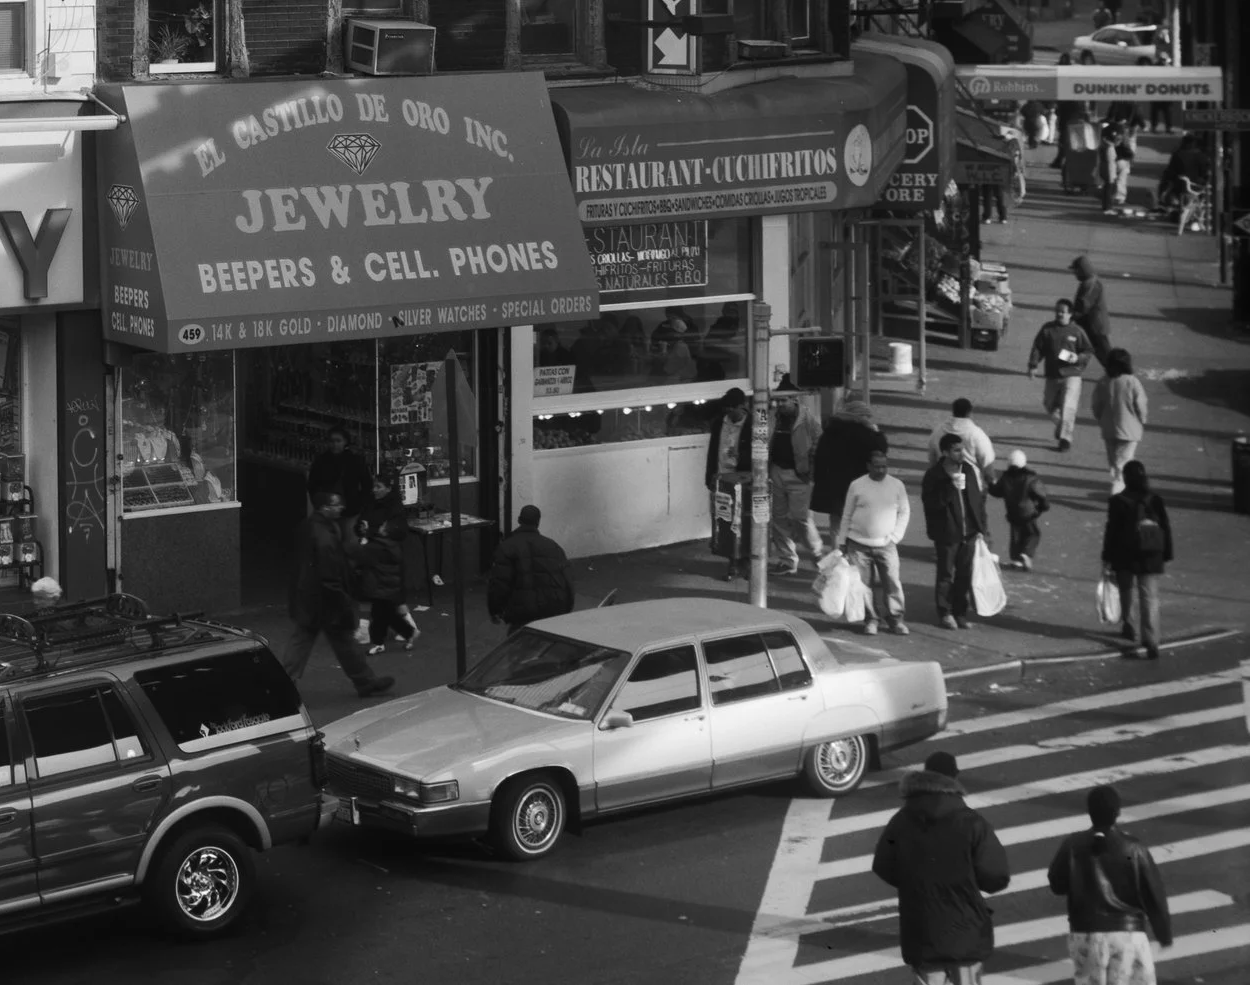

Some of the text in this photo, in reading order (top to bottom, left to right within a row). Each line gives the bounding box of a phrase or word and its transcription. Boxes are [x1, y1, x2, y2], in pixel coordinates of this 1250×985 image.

[1073, 83, 1142, 95] DUNKIN'
[1145, 84, 1212, 95] DONUTS
[192, 92, 515, 178] EL CASTILLO DE ORO INC.
[906, 128, 929, 144] OP
[889, 173, 939, 187] CERY
[235, 176, 494, 234] JEWELRY
[586, 204, 613, 219] FRITURAS
[613, 203, 618, 217] Y
[618, 200, 657, 217] CUCHIFRITOS
[744, 191, 771, 207] CRIOLLAS
[794, 185, 827, 202] TROPICALES
[884, 188, 925, 202] ORE
[585, 220, 702, 254] STAURANT
[109, 247, 153, 272] JEWELRY
[198, 240, 559, 294] BEEPERS & CELL. PHONES
[605, 272, 669, 290] NATURALES
[113, 284, 149, 309] BEEPERS
[111, 311, 155, 338] CELL. PHONES
[182, 295, 592, 341] 459 14K & 18K GOLD DIAMOND SILVER WATCHES SPECIAL ORDERS
